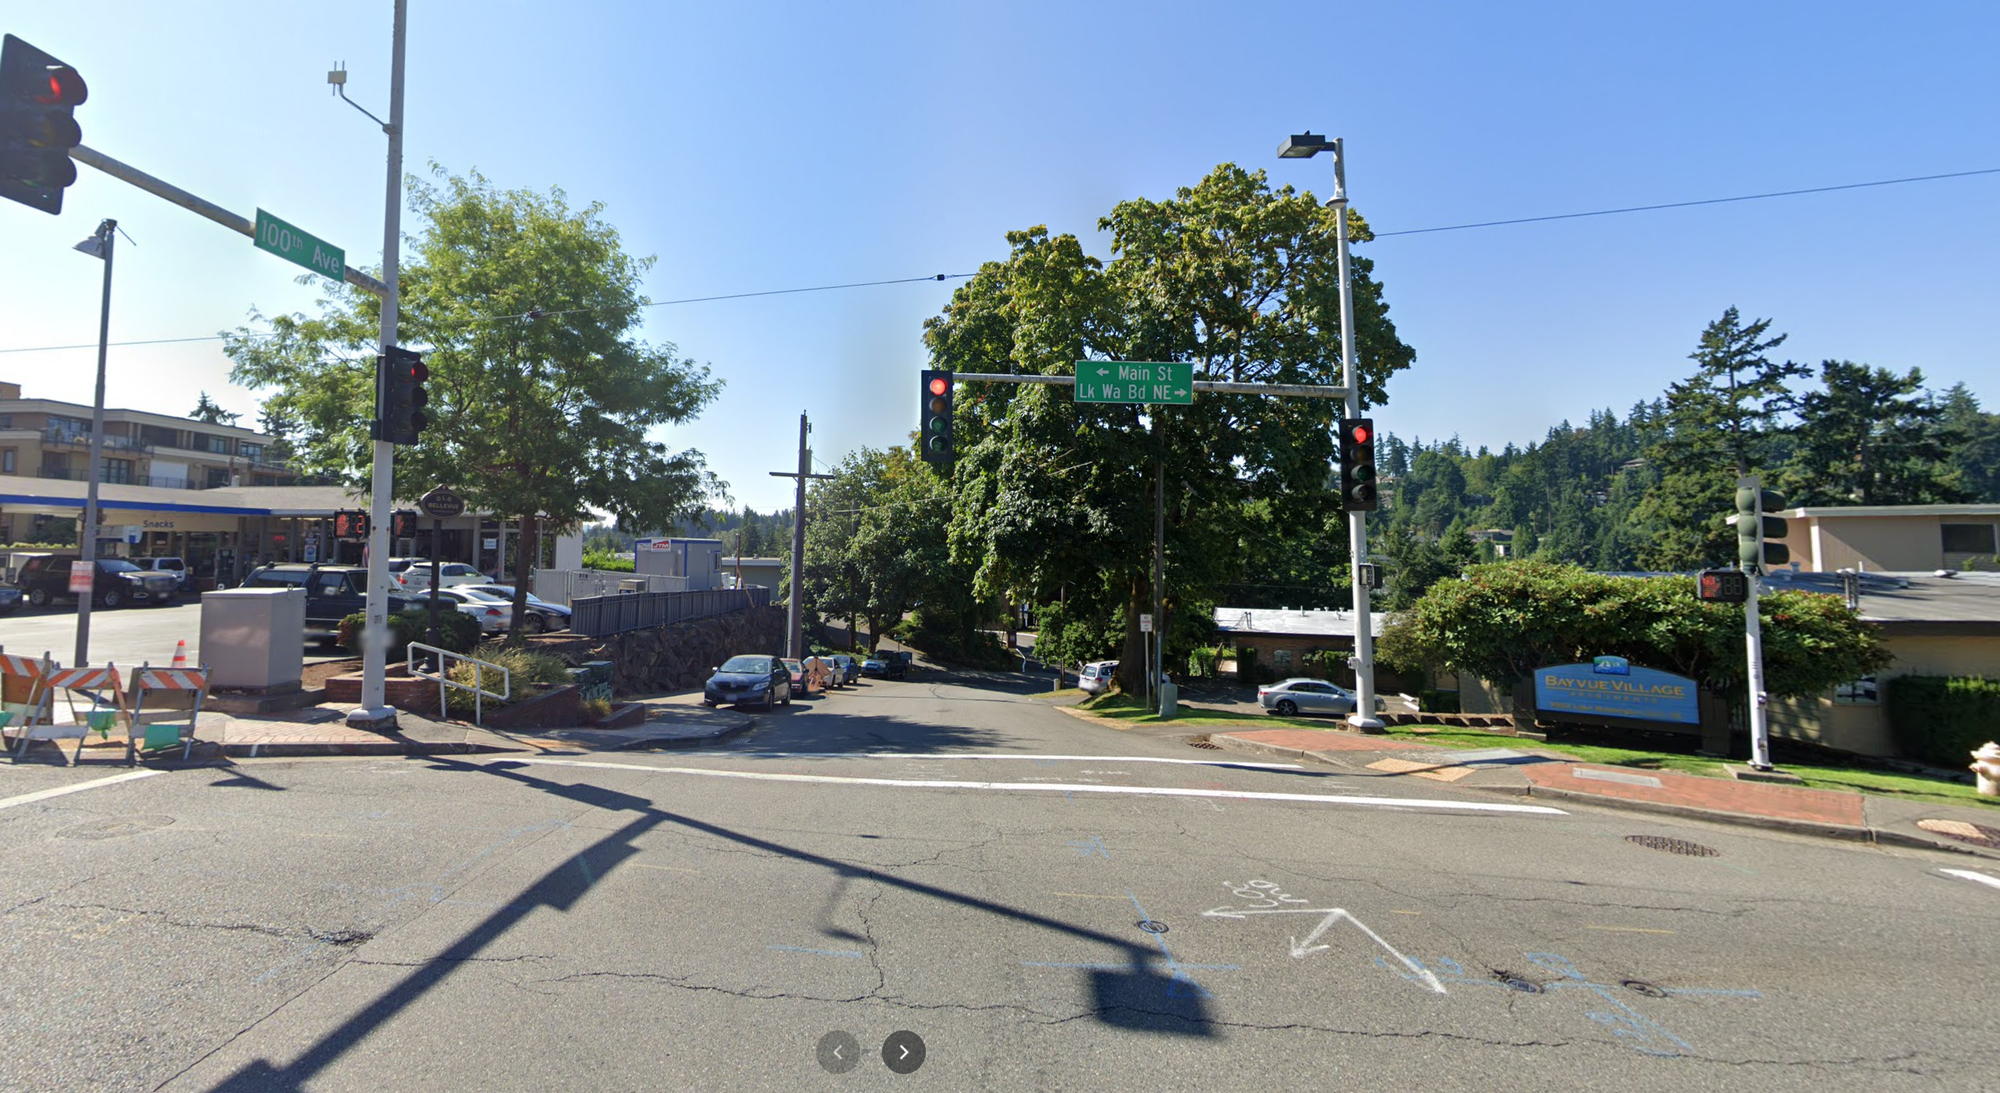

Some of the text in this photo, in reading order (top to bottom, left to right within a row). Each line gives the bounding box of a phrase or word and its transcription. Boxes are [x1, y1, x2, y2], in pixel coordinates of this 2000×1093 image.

[262, 219, 340, 273] 100th Ave
[1118, 365, 1173, 381] Main St
[1080, 383, 1171, 400] Lk Wa Bd NE
[143, 519, 174, 528] Snacks
[1545, 675, 1686, 696] BAYVUE VILLAGE
